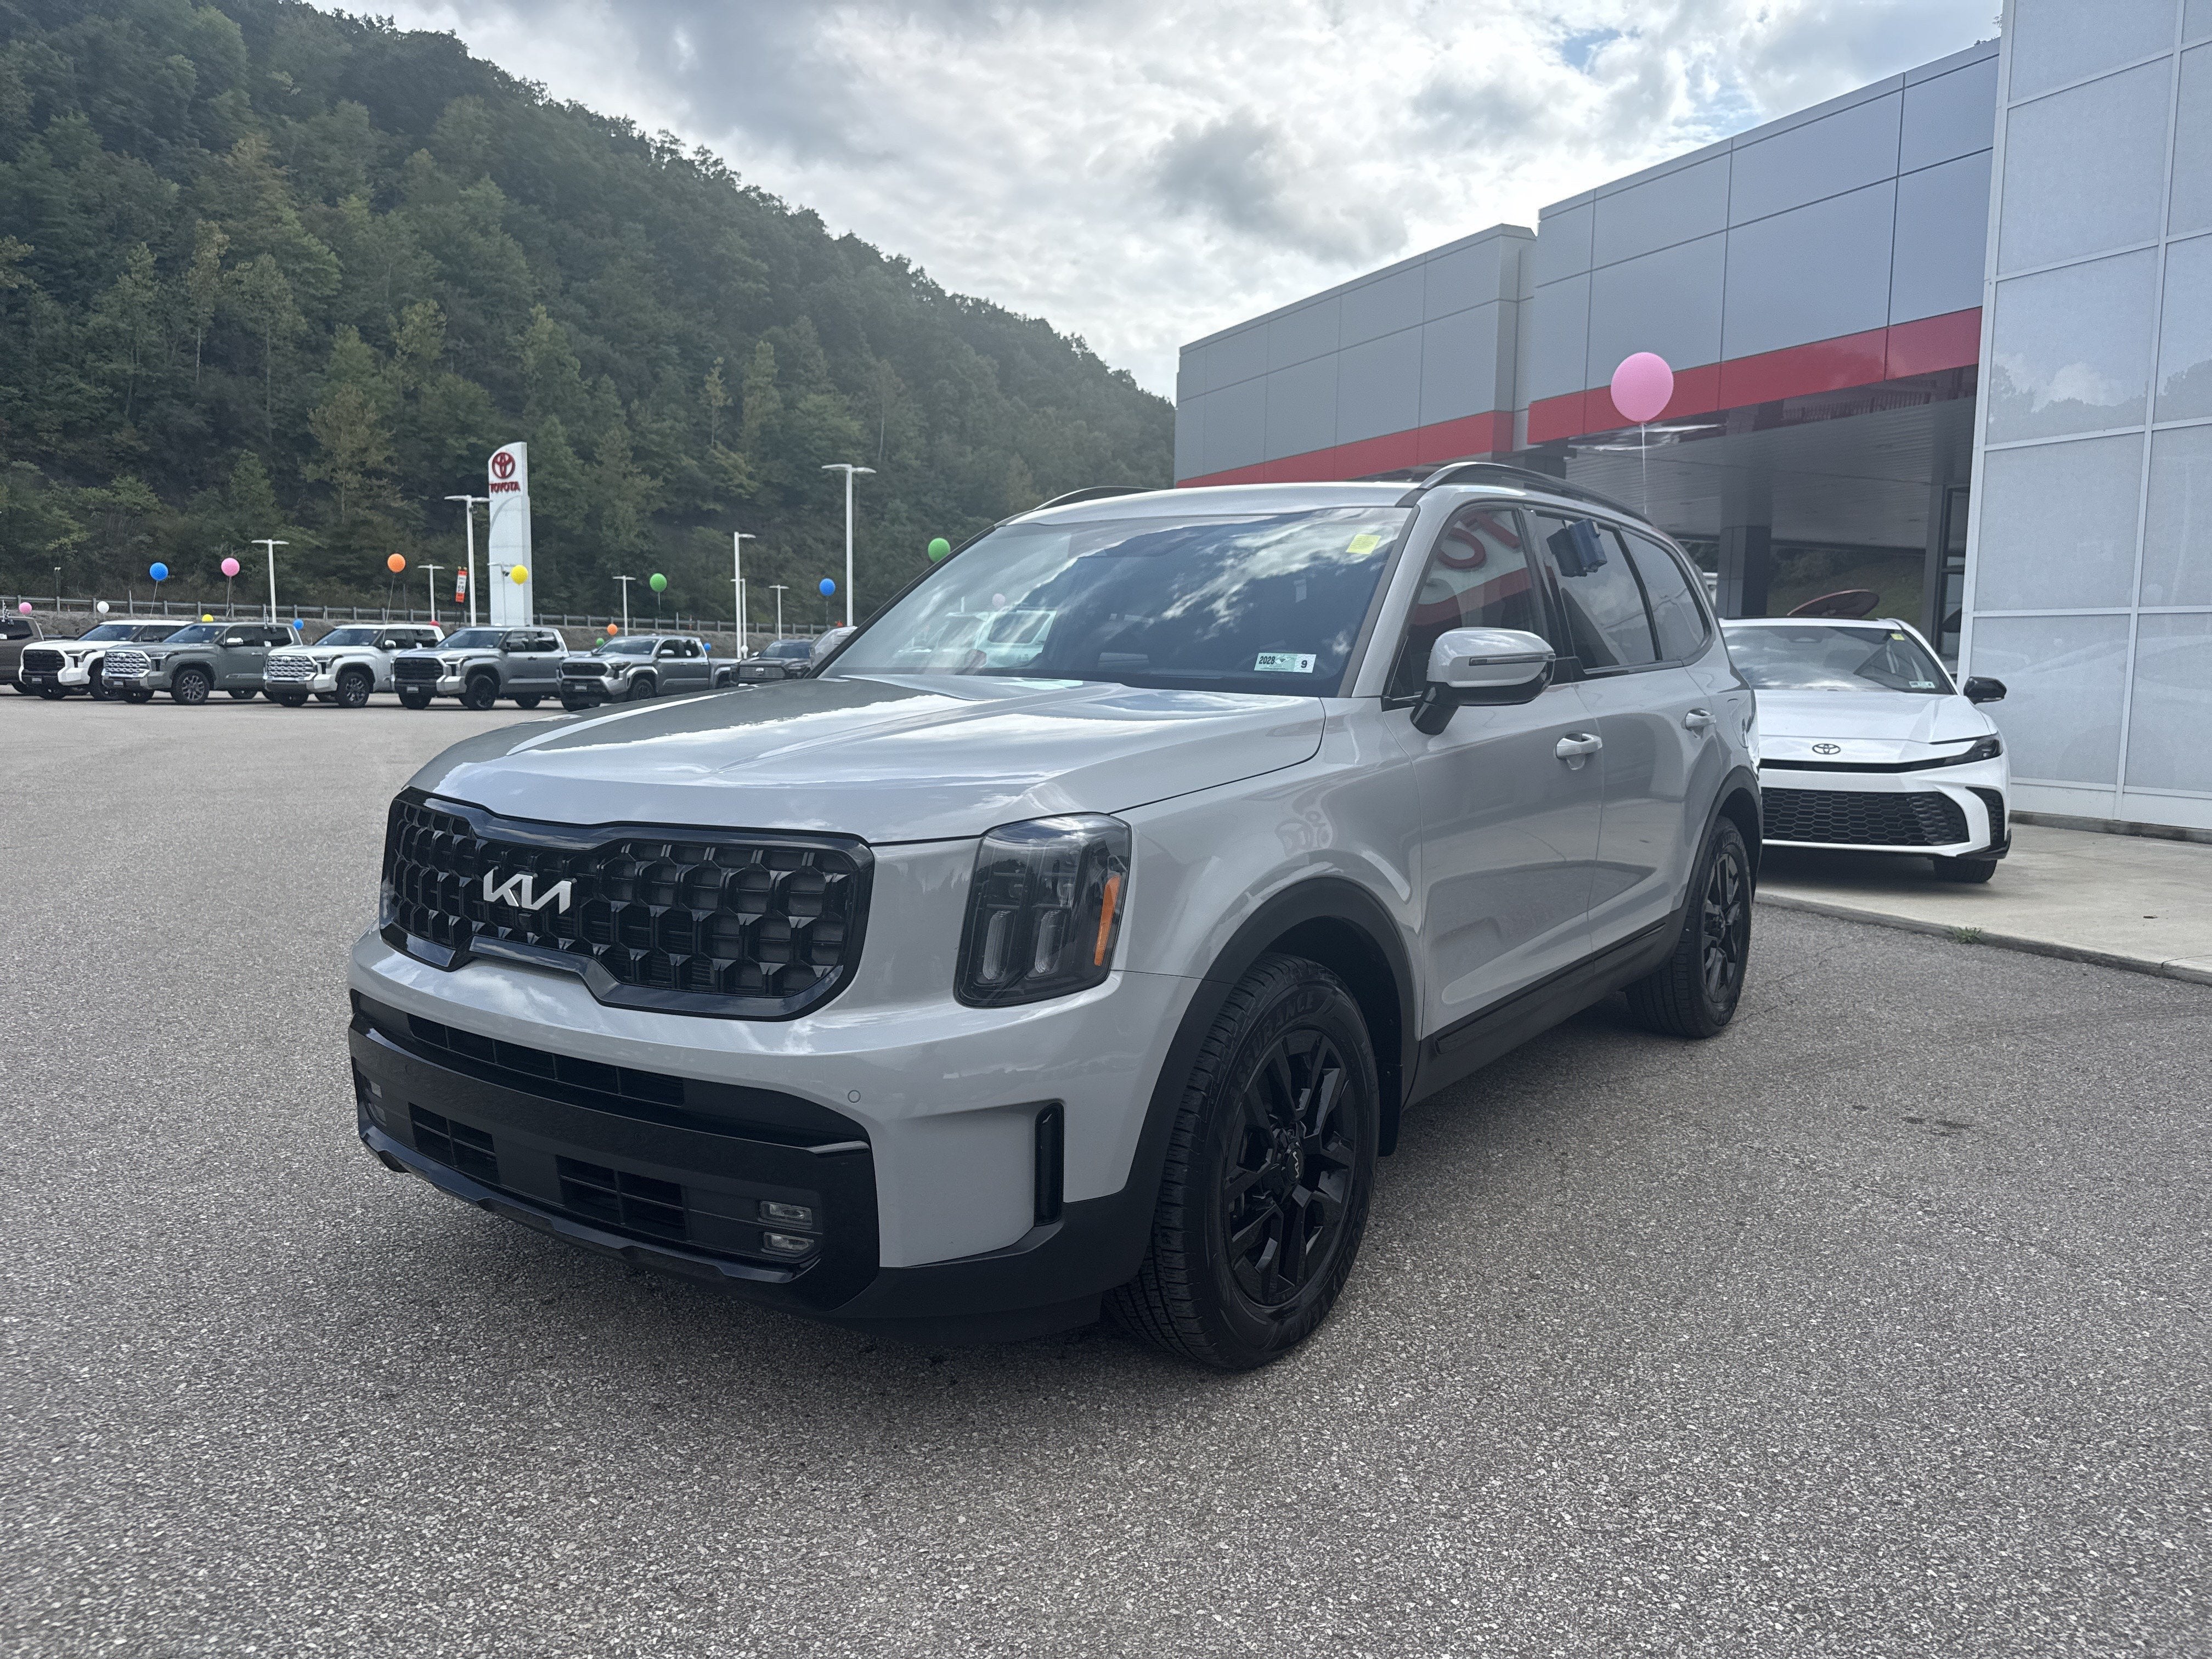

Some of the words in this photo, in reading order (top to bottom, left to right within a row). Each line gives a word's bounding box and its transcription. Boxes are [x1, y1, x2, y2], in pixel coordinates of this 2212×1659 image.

[489, 481, 521, 493] TOYOTA
[1259, 656, 1276, 664] 2028
[1301, 660, 1307, 668] 9
[483, 868, 572, 914] KIA
[1228, 990, 1313, 1103] ASSURANCE
